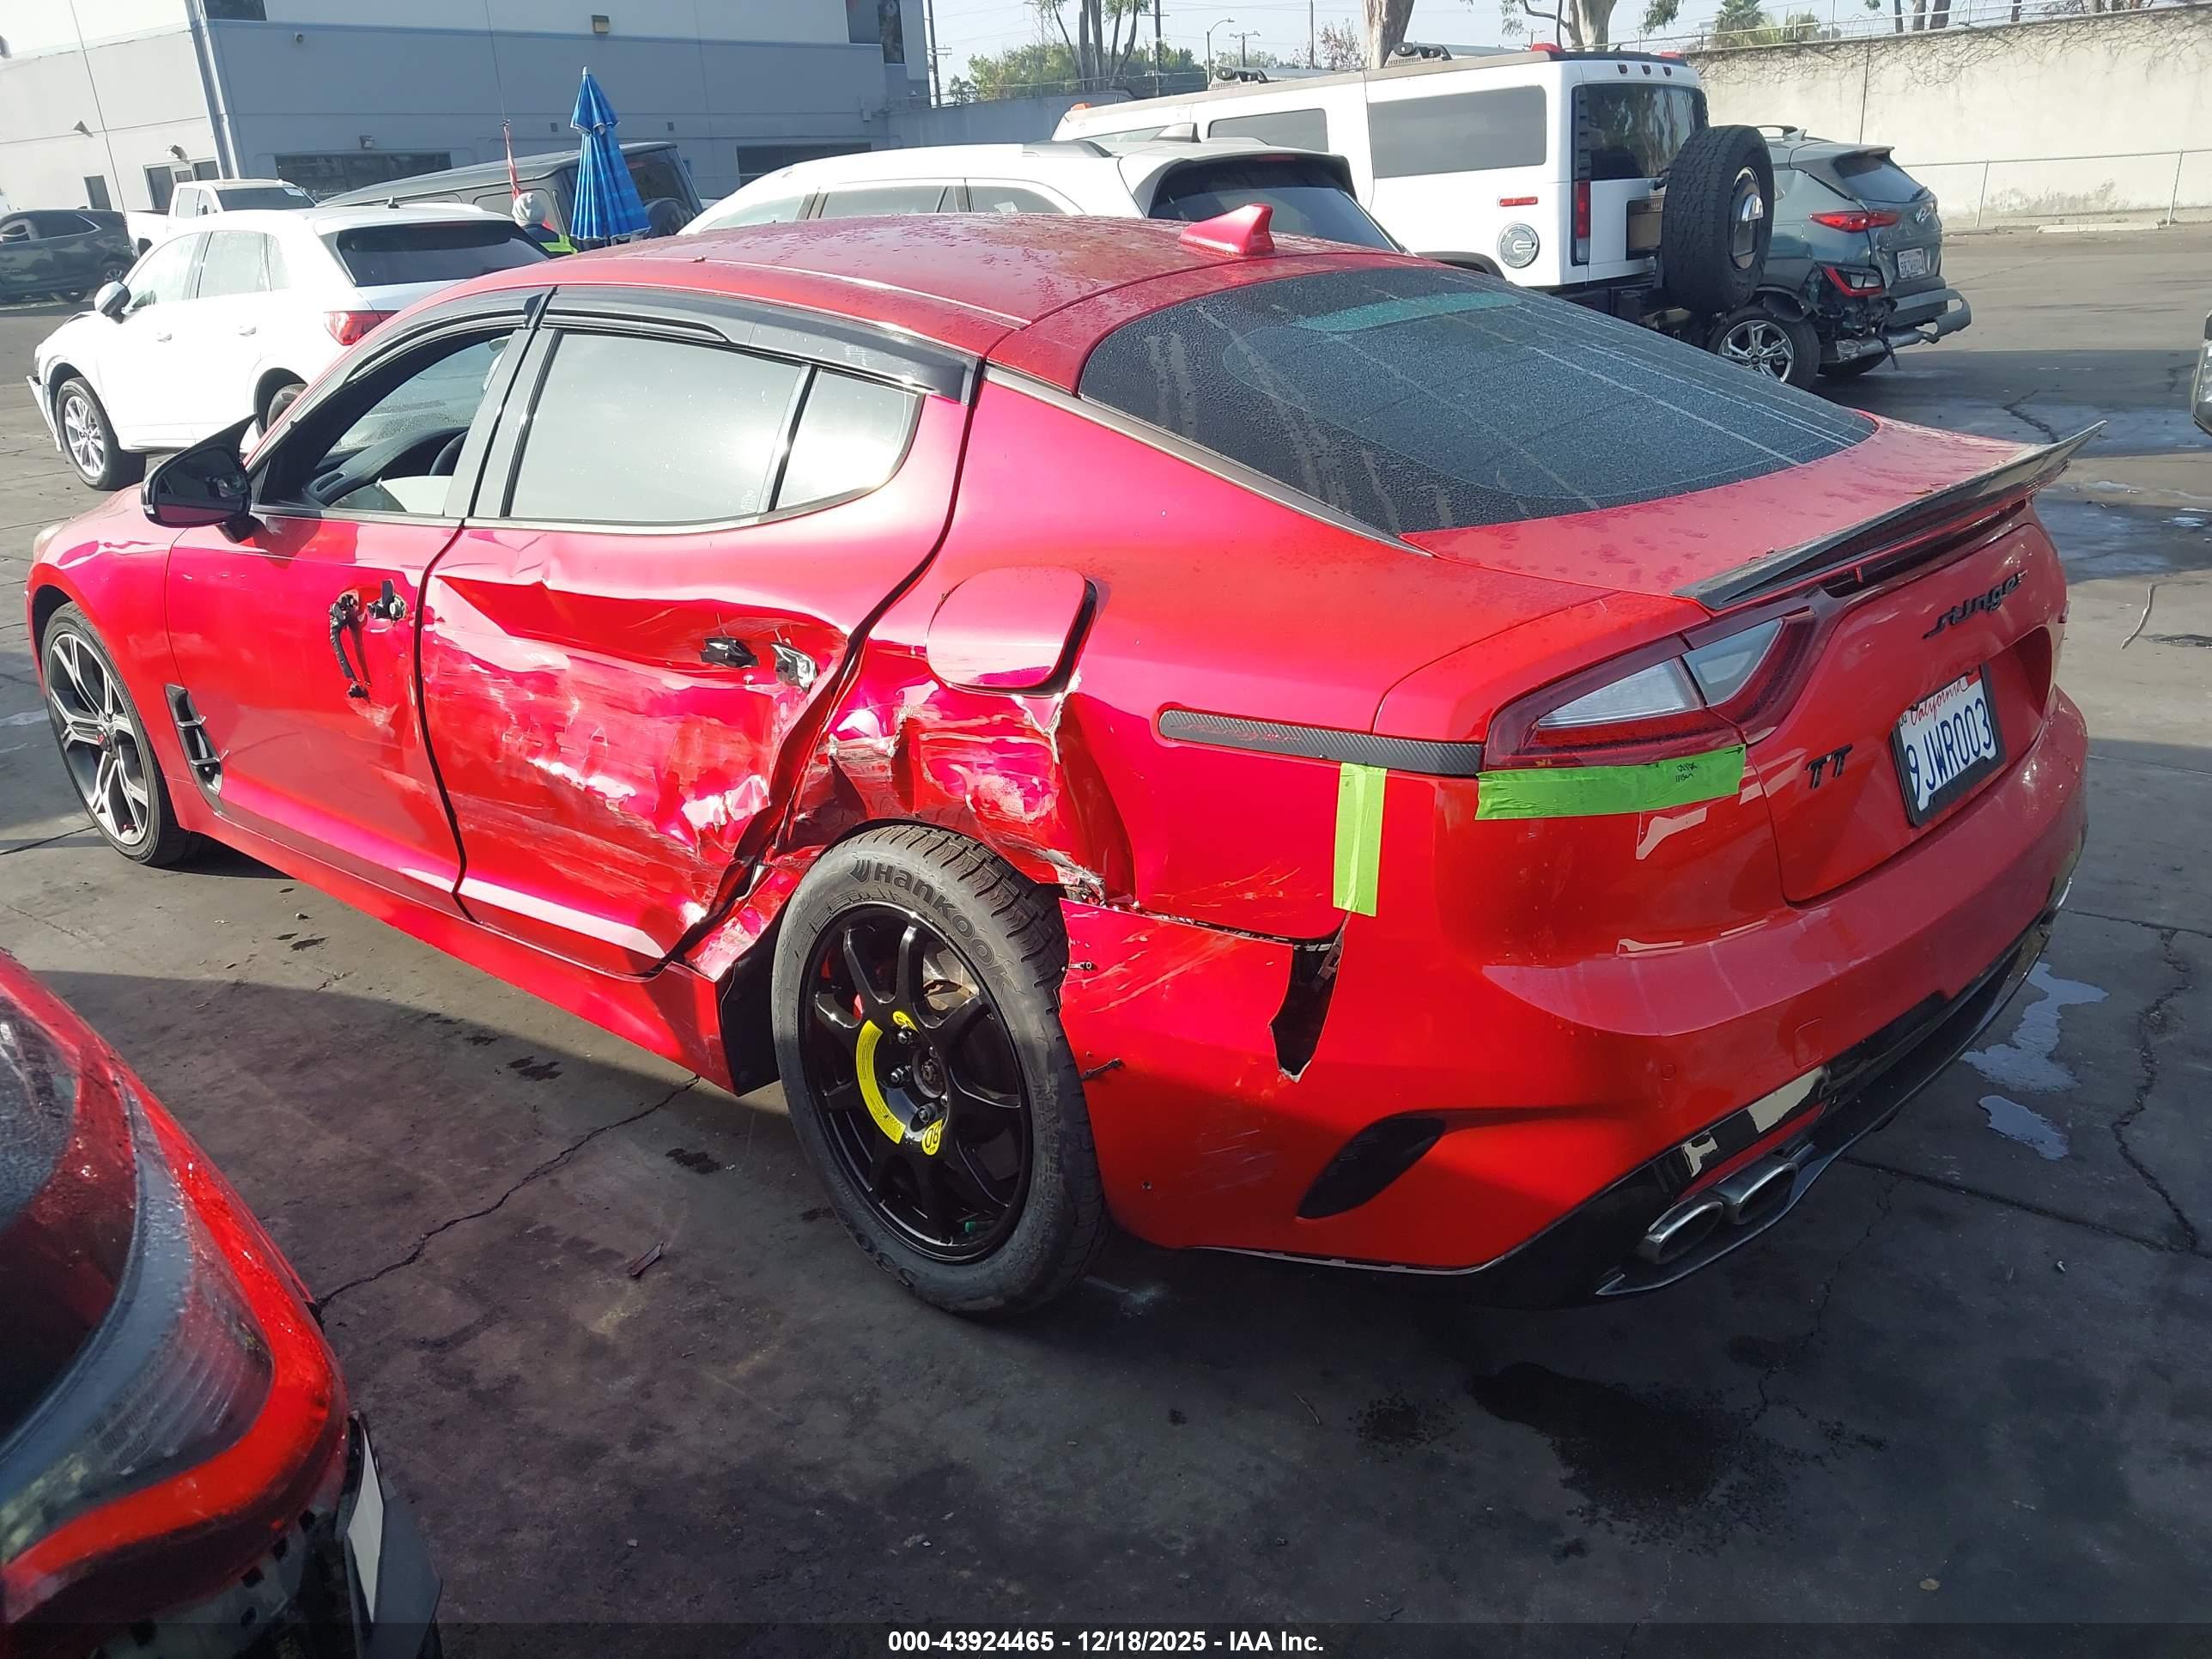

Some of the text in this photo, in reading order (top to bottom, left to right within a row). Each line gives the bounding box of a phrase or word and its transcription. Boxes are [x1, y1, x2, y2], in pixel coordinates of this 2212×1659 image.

[1922, 568, 2028, 639] Stinger
[1805, 743, 1854, 790] TT
[1905, 697, 1992, 803] 9JWR003
